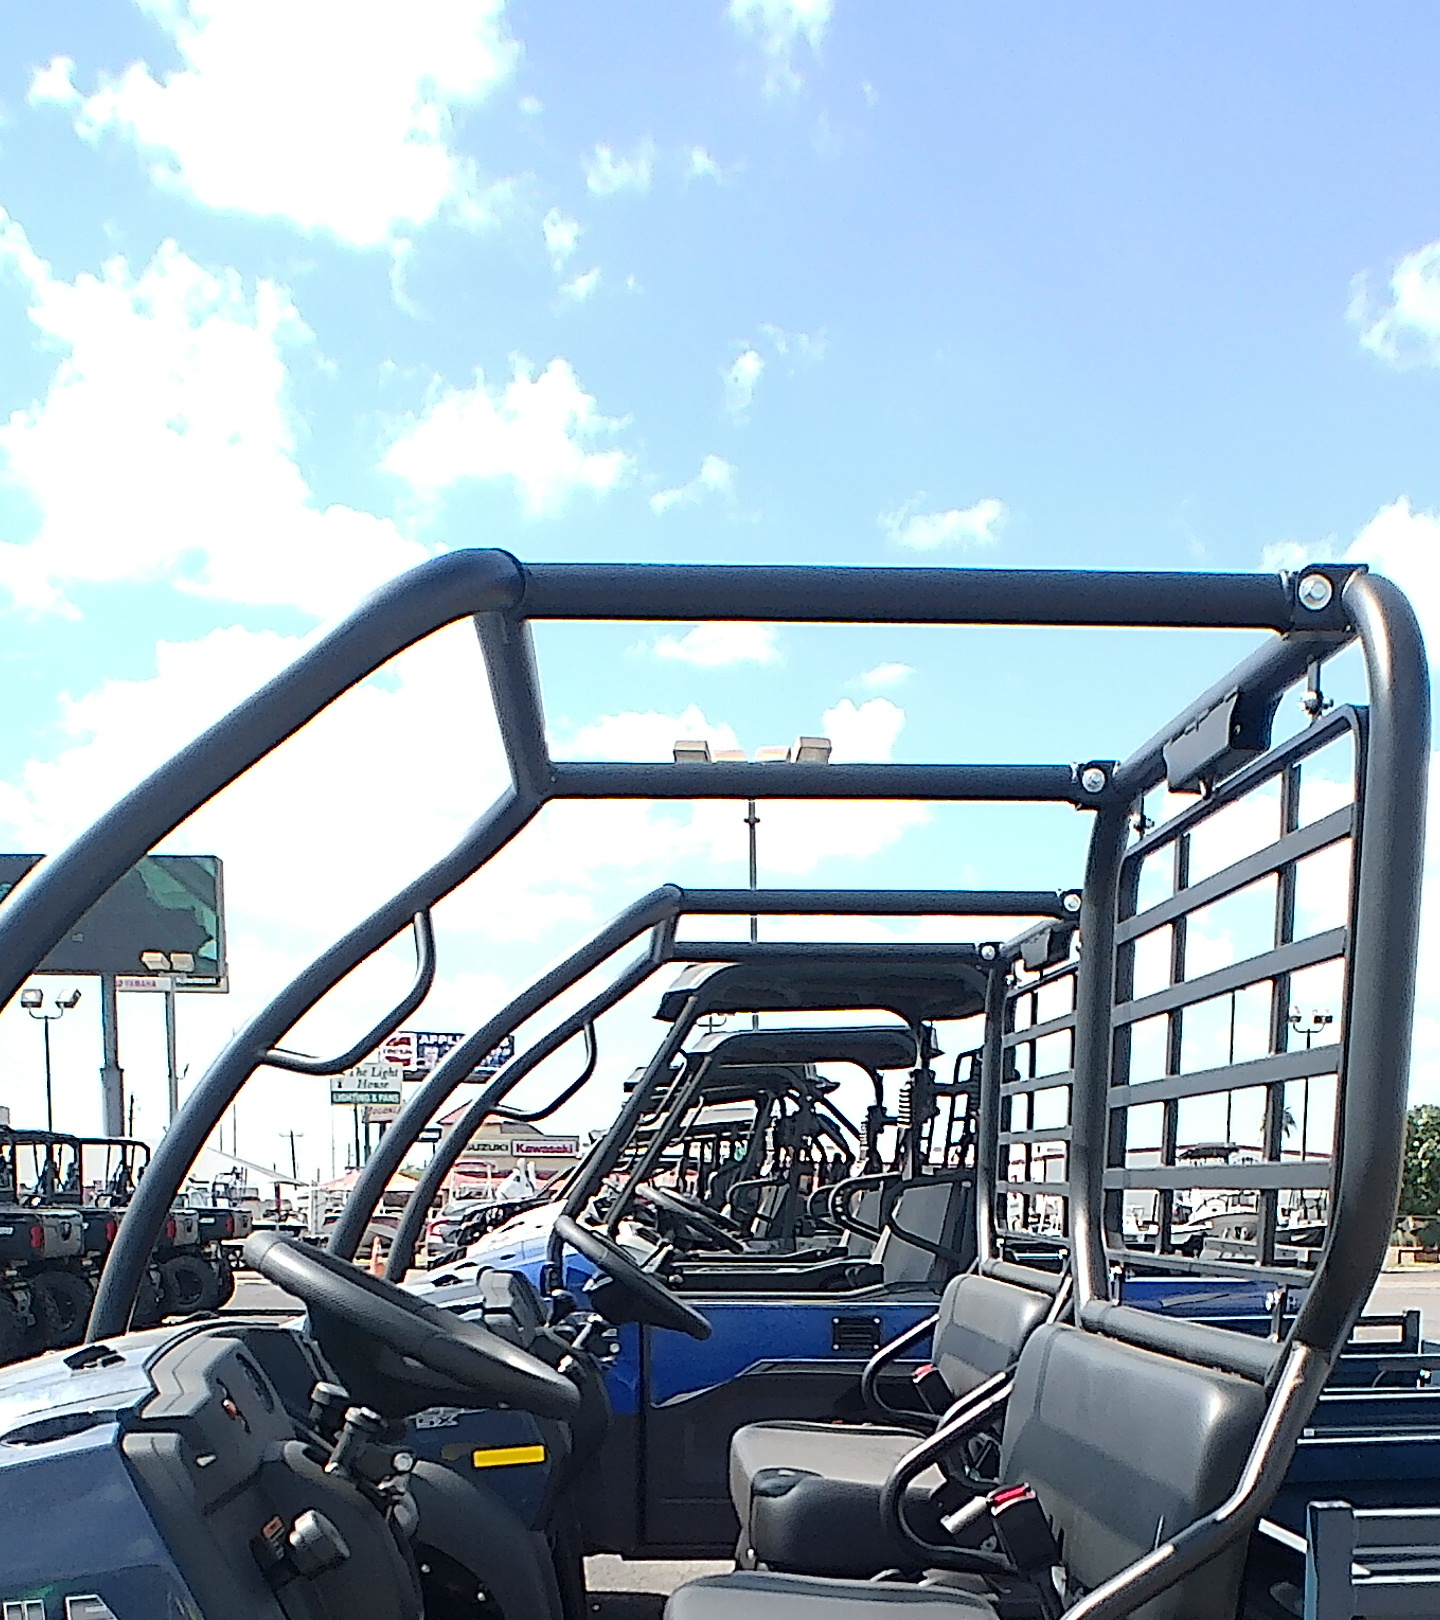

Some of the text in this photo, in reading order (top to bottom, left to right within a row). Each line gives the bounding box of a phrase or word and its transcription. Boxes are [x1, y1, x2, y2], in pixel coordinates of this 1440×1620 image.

[371, 1066, 398, 1080] Light
[357, 1079, 389, 1089] House
[516, 1143, 573, 1153] Kawasaki
